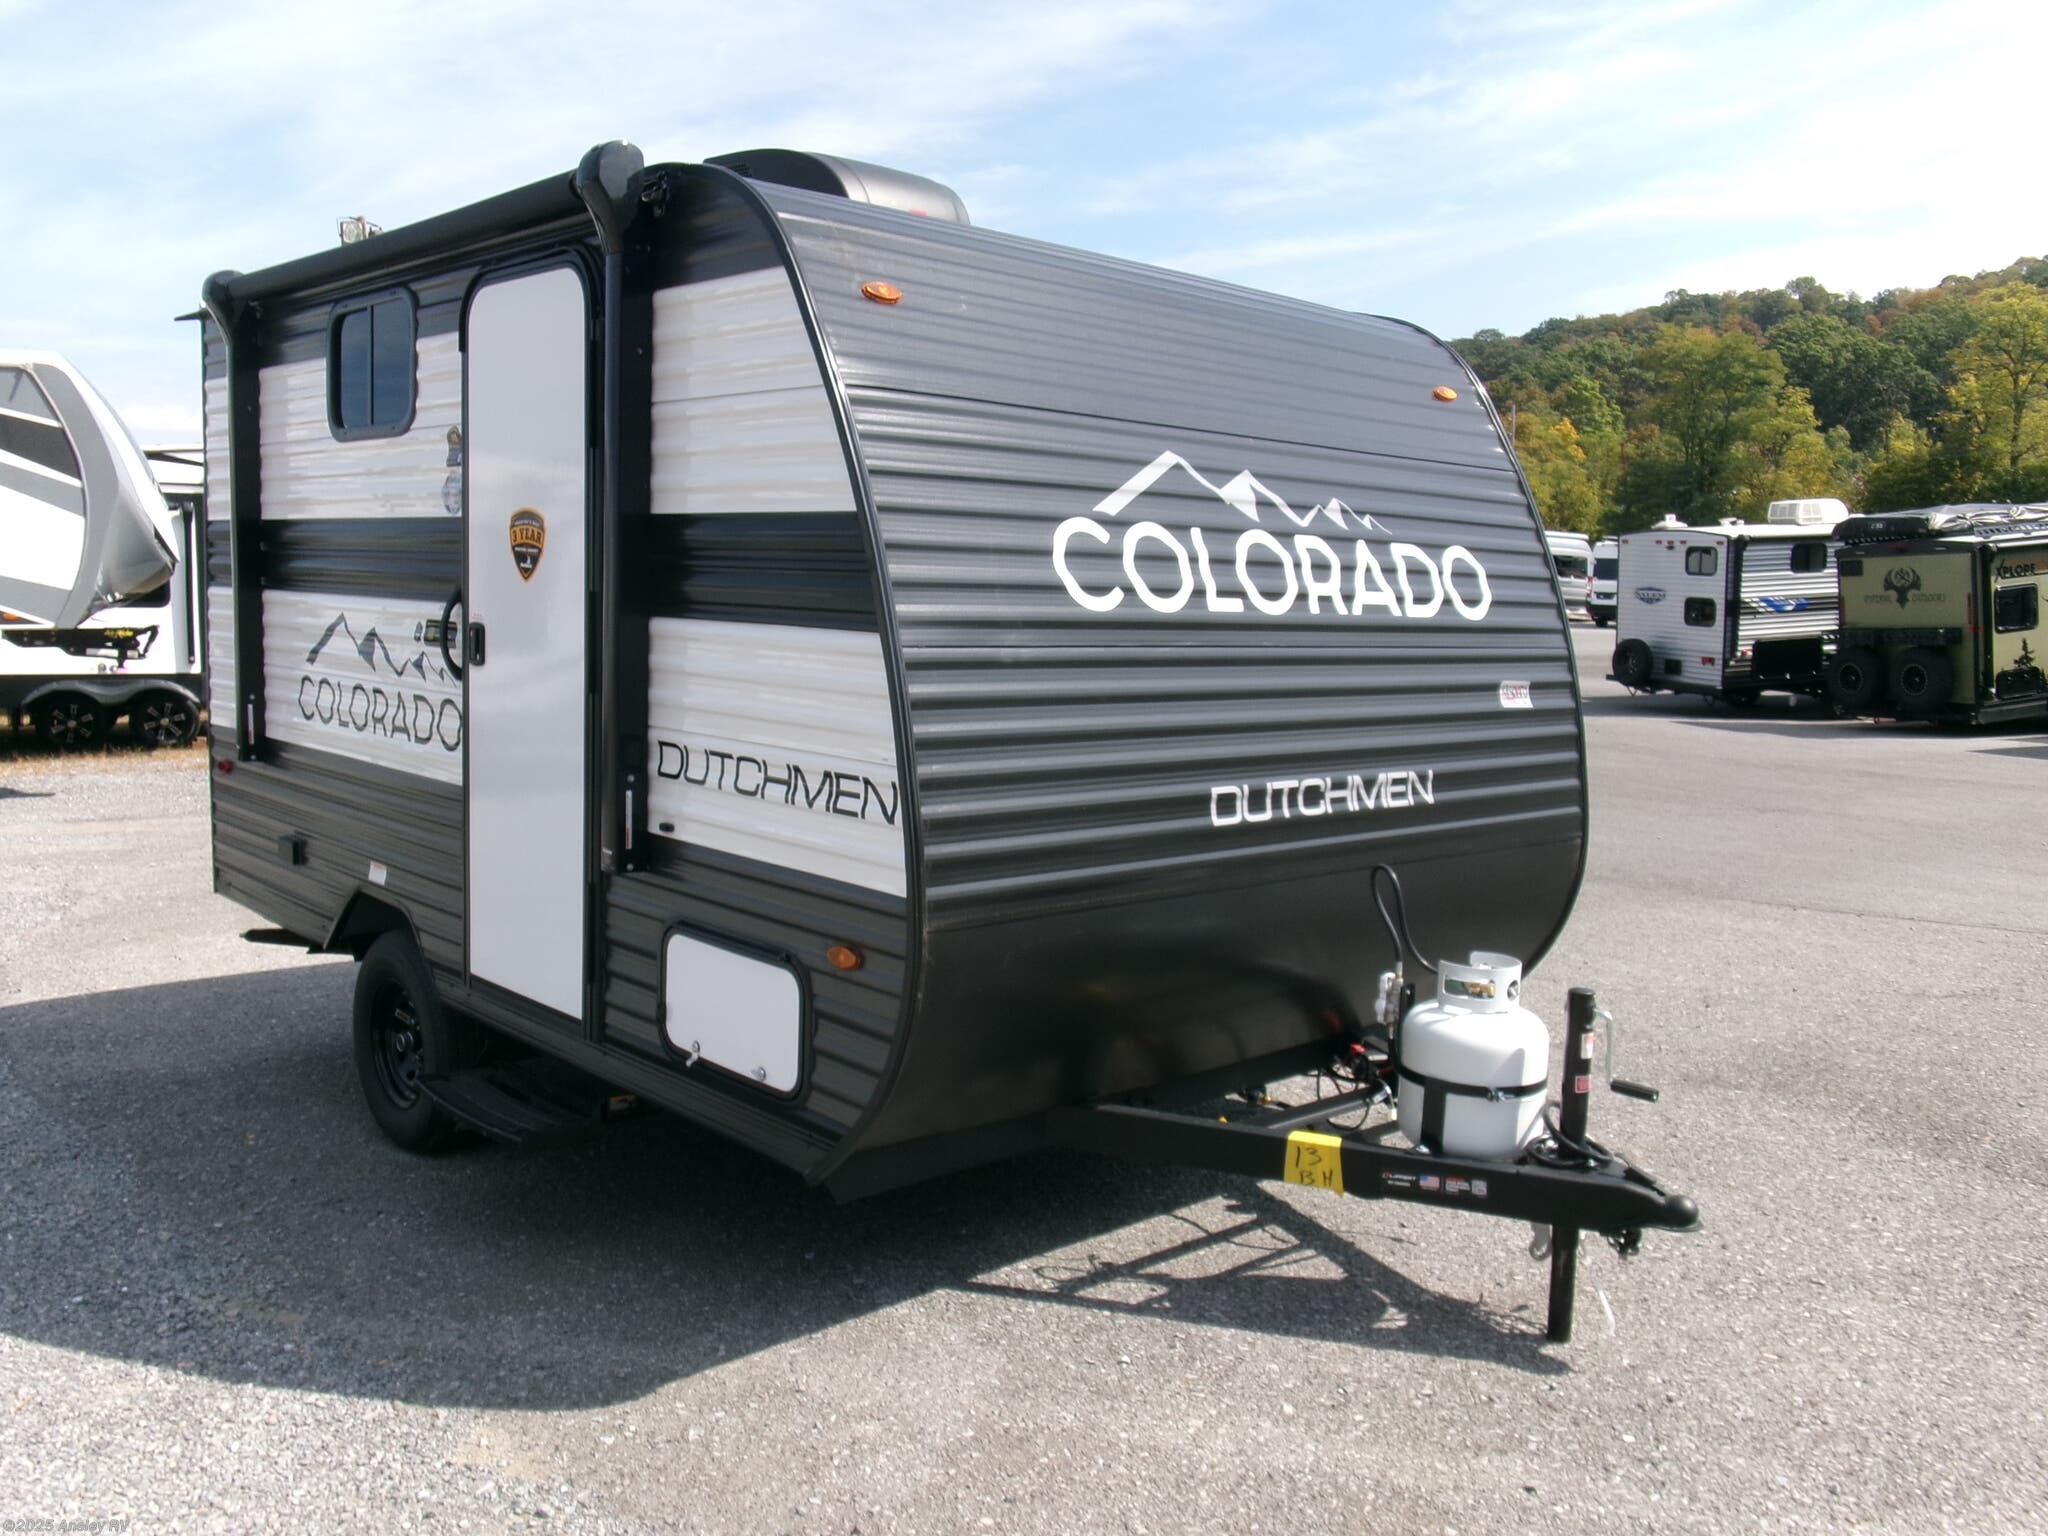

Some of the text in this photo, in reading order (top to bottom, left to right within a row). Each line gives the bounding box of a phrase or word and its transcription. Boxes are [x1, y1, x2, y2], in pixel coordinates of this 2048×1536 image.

[512, 527, 541, 545] 3 YEAR
[1052, 516, 1492, 621] COLORADO
[299, 675, 463, 752] COLORADO
[657, 740, 898, 826] DUTCHMEN
[1210, 769, 1435, 827] DUTCHMEN
[1295, 1146, 1322, 1169] 13
